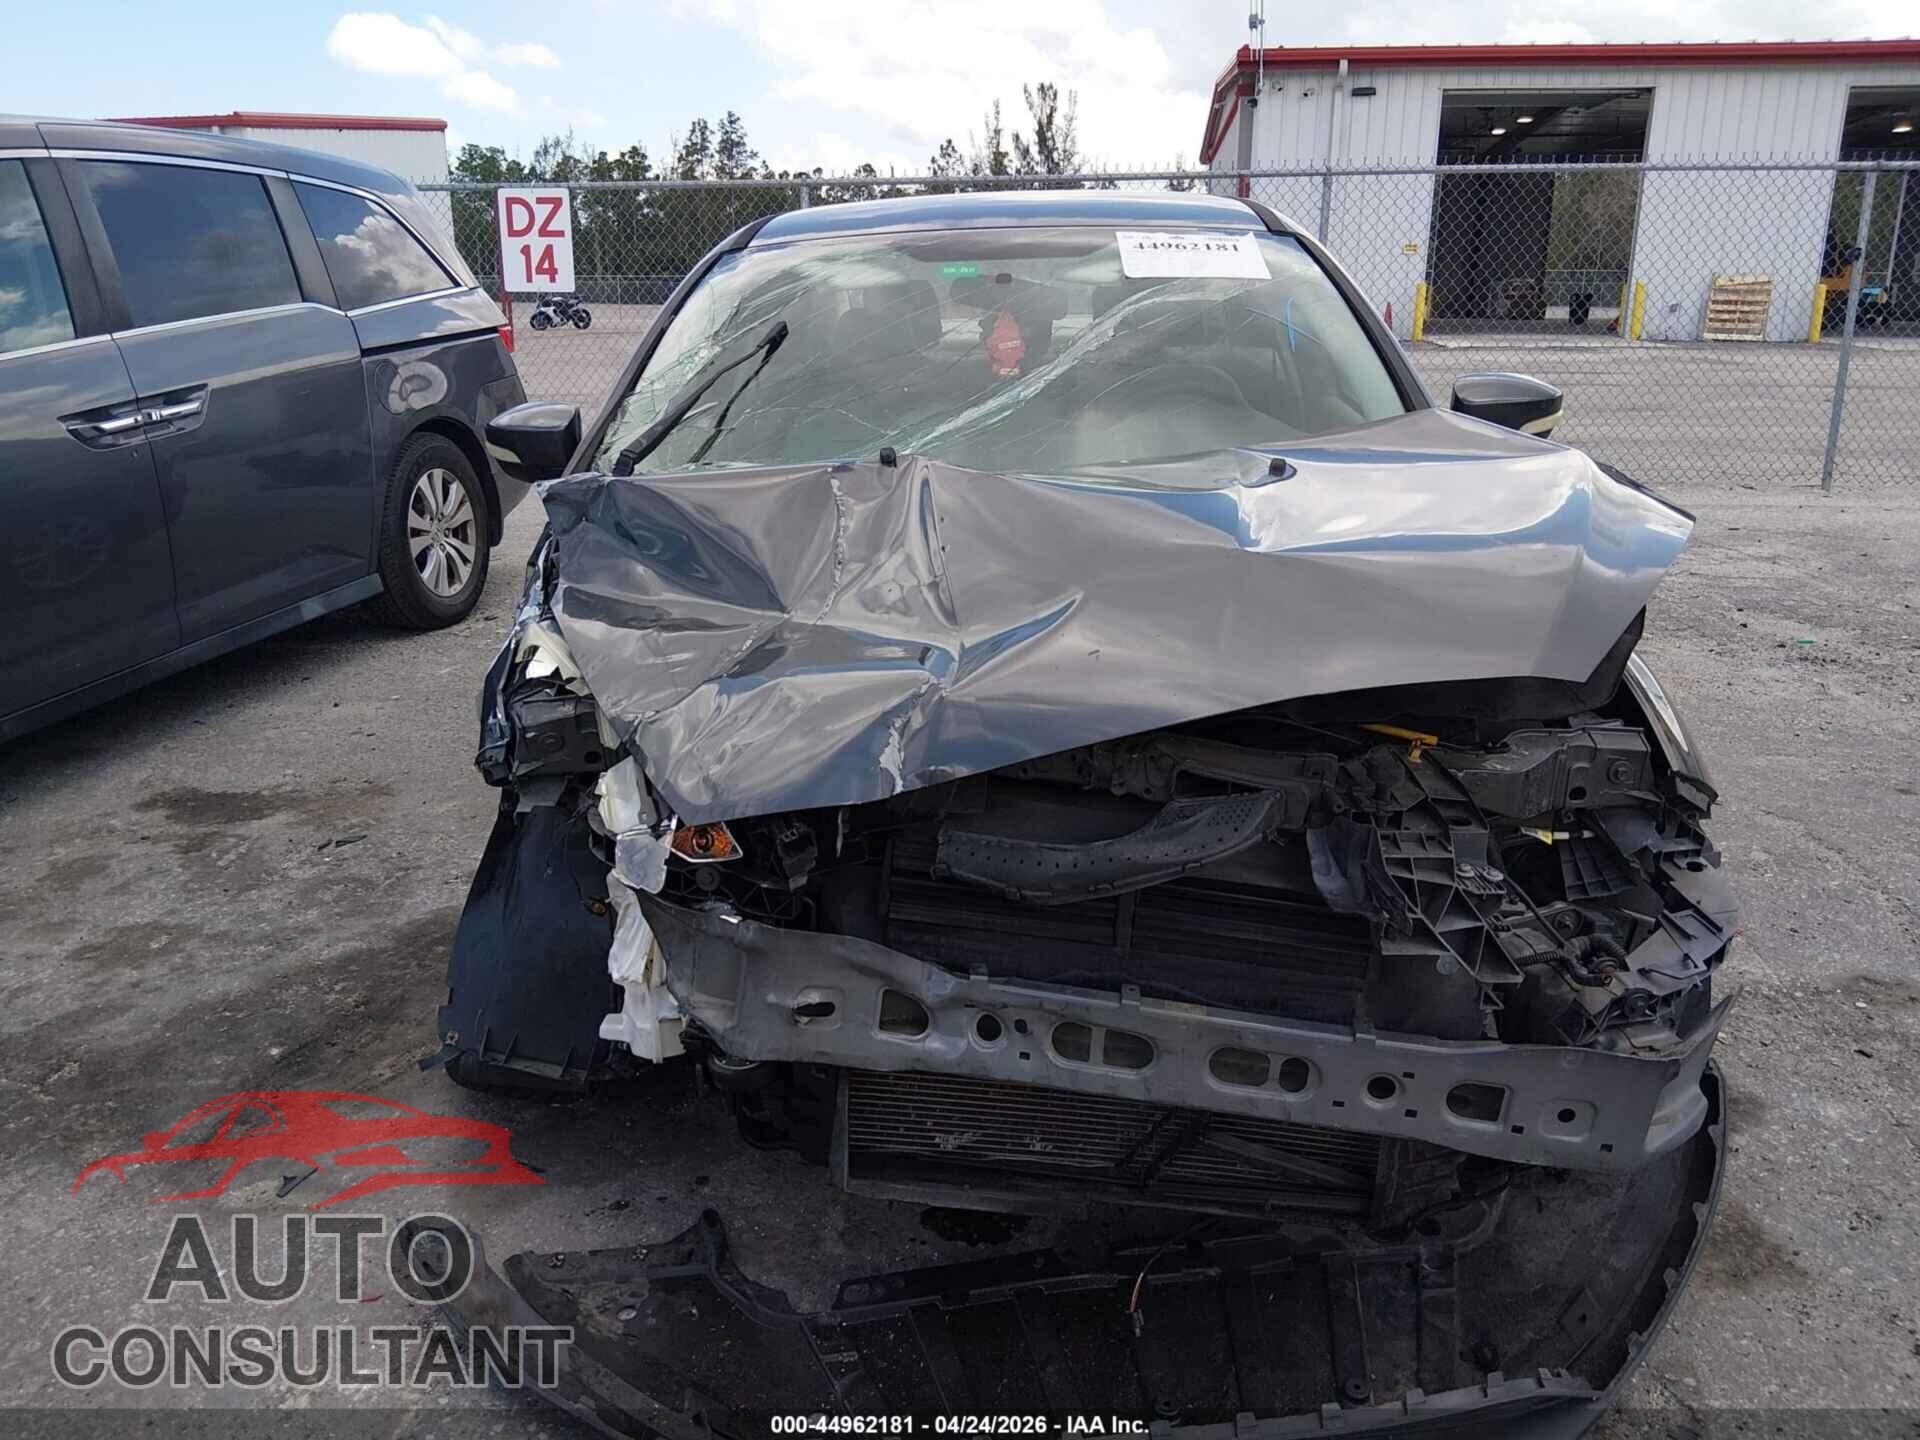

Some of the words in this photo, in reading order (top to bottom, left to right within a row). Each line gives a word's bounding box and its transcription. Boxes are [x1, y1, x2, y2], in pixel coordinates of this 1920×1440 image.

[505, 197, 565, 237] DZ
[520, 244, 558, 283] 14
[1133, 241, 1239, 253] 44962181
